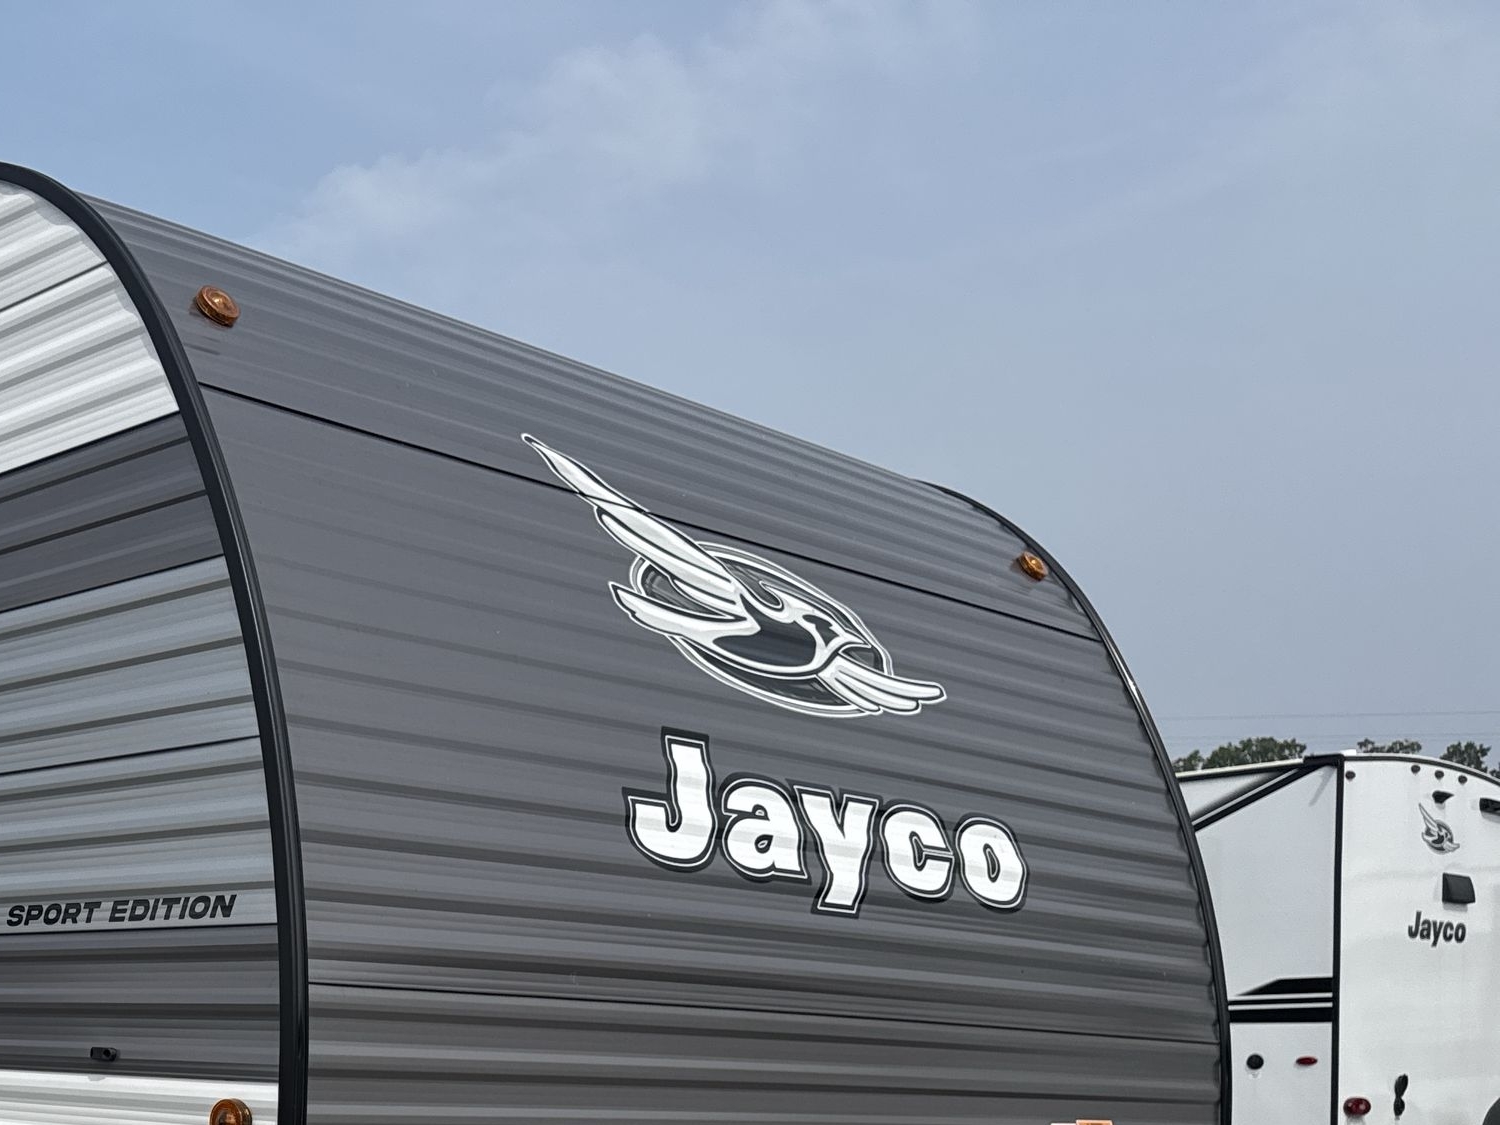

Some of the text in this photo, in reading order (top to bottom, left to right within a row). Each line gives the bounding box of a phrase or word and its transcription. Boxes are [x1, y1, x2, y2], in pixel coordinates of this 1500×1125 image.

[624, 728, 1028, 917] Jayco
[6, 894, 237, 927] SPORT EDITION
[1407, 910, 1467, 948] Jayco
